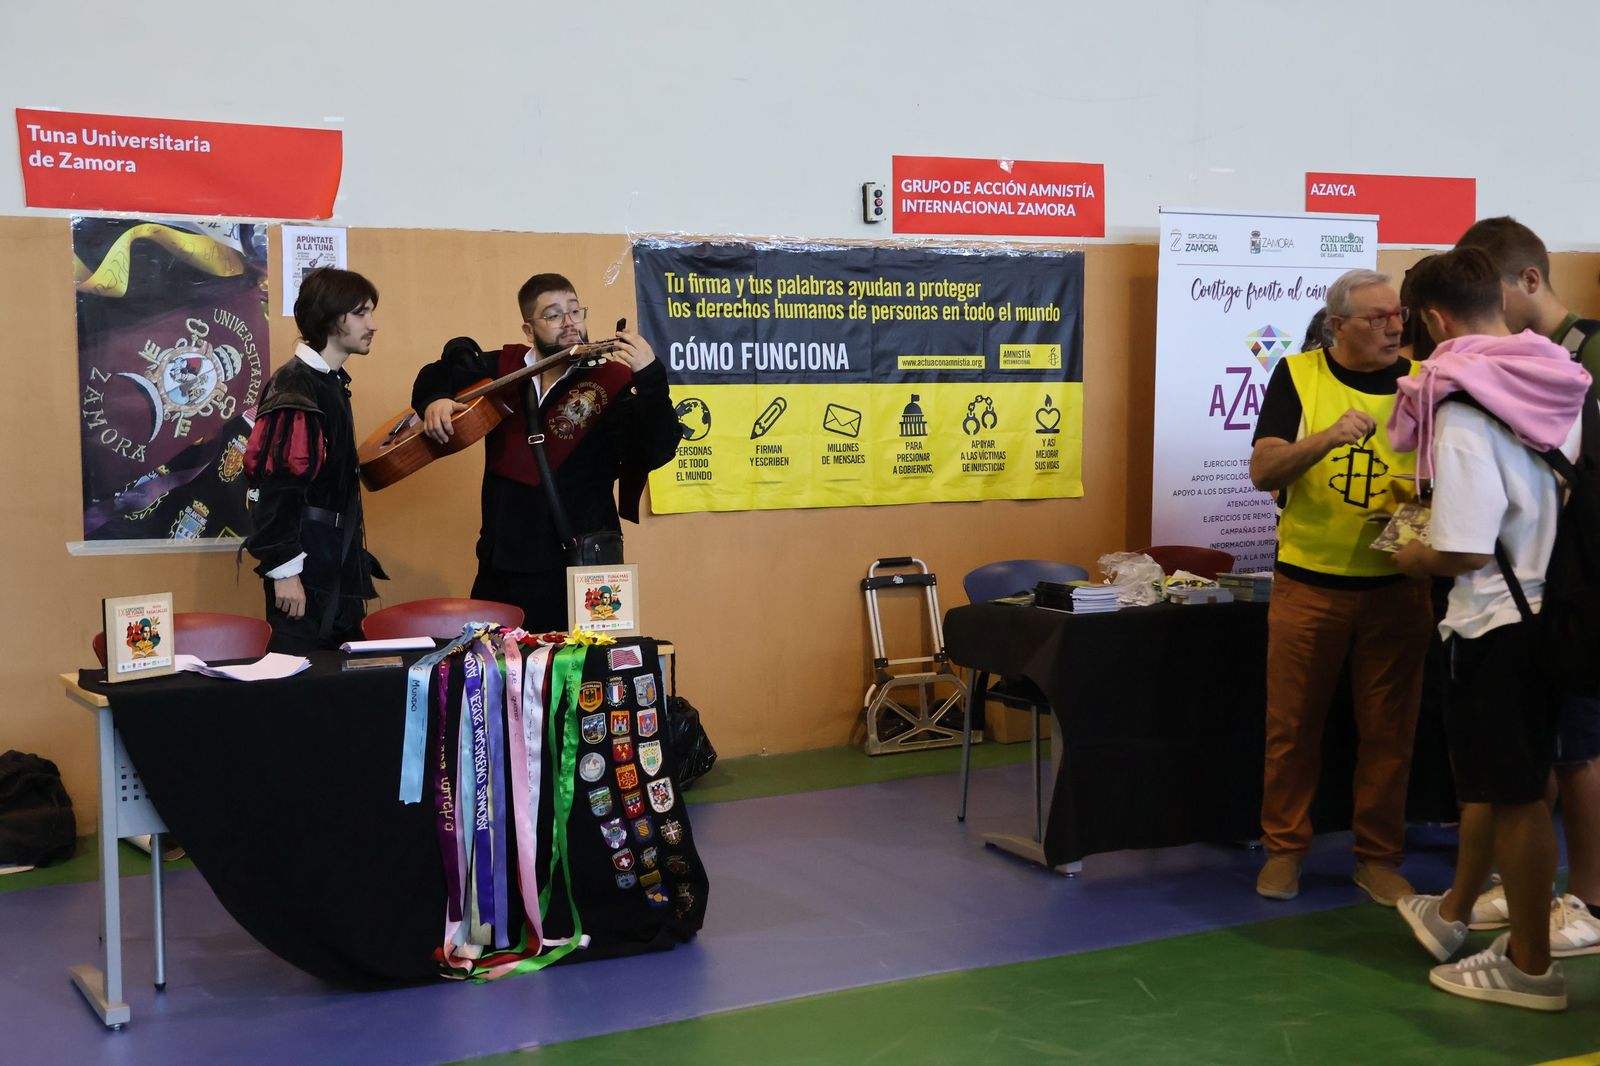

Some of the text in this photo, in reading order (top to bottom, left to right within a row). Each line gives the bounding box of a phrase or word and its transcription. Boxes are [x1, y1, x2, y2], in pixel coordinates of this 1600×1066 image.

[26, 124, 211, 153] Tuna Universitaria
[28, 151, 136, 173] de Zamora
[901, 179, 1095, 198] GRUPO DE ACCIÓN AMNISTÍA
[1310, 183, 1356, 197] AZAYCA
[902, 199, 1076, 217] INTERNACIONAL ZAMORA
[296, 234, 334, 245] APÚNTATE
[1262, 238, 1295, 248] ZAMORA
[1185, 243, 1219, 252] ZAMORA
[1320, 244, 1364, 253] CAJA RURAL
[664, 272, 982, 302] Tu firma y tus palabras ayudan a proteger
[1191, 277, 1244, 314] Contigo
[1246, 280, 1284, 310] frente
[1287, 276, 1303, 301] al
[667, 297, 1061, 324] los derechos humanos de personas en todo el mundo
[213, 308, 262, 405] UNIVERSITARIA
[670, 336, 850, 371] CÓMO FUNCIONA
[1003, 349, 1031, 359] AMNISTÍA
[902, 357, 983, 368] www.actuaconamnistia.org
[82, 366, 147, 462] ZAMORA
[827, 443, 860, 453] MILLONES
[905, 441, 923, 451] PARA
[971, 440, 996, 449] APOYAR
[1041, 439, 1047, 447] Y
[675, 446, 712, 456] PERSONAS
[755, 445, 783, 455] FIRMAN
[822, 454, 866, 465] DE MENSAJES
[896, 453, 930, 463] PRESIONAR
[960, 450, 1007, 461] A LAS VÍCTIMAS
[678, 458, 709, 469] DE TODO
[749, 457, 789, 467] Y ESCRIBEN
[1035, 461, 1046, 471] SUS
[1204, 460, 1238, 468] EJERCICIO
[892, 466, 898, 474] A
[962, 462, 1006, 473] DE INJUSTICIAS
[676, 471, 712, 481] EL MUNDO
[1191, 474, 1215, 482] APOYO
[1204, 488, 1217, 496] LOS
[1227, 499, 1260, 508] ATENCIÓN
[1203, 514, 1241, 523] EJERCICIOS
[1220, 526, 1256, 536] CAMPAÑAS
[1210, 540, 1256, 550] INFORMACIÓN
